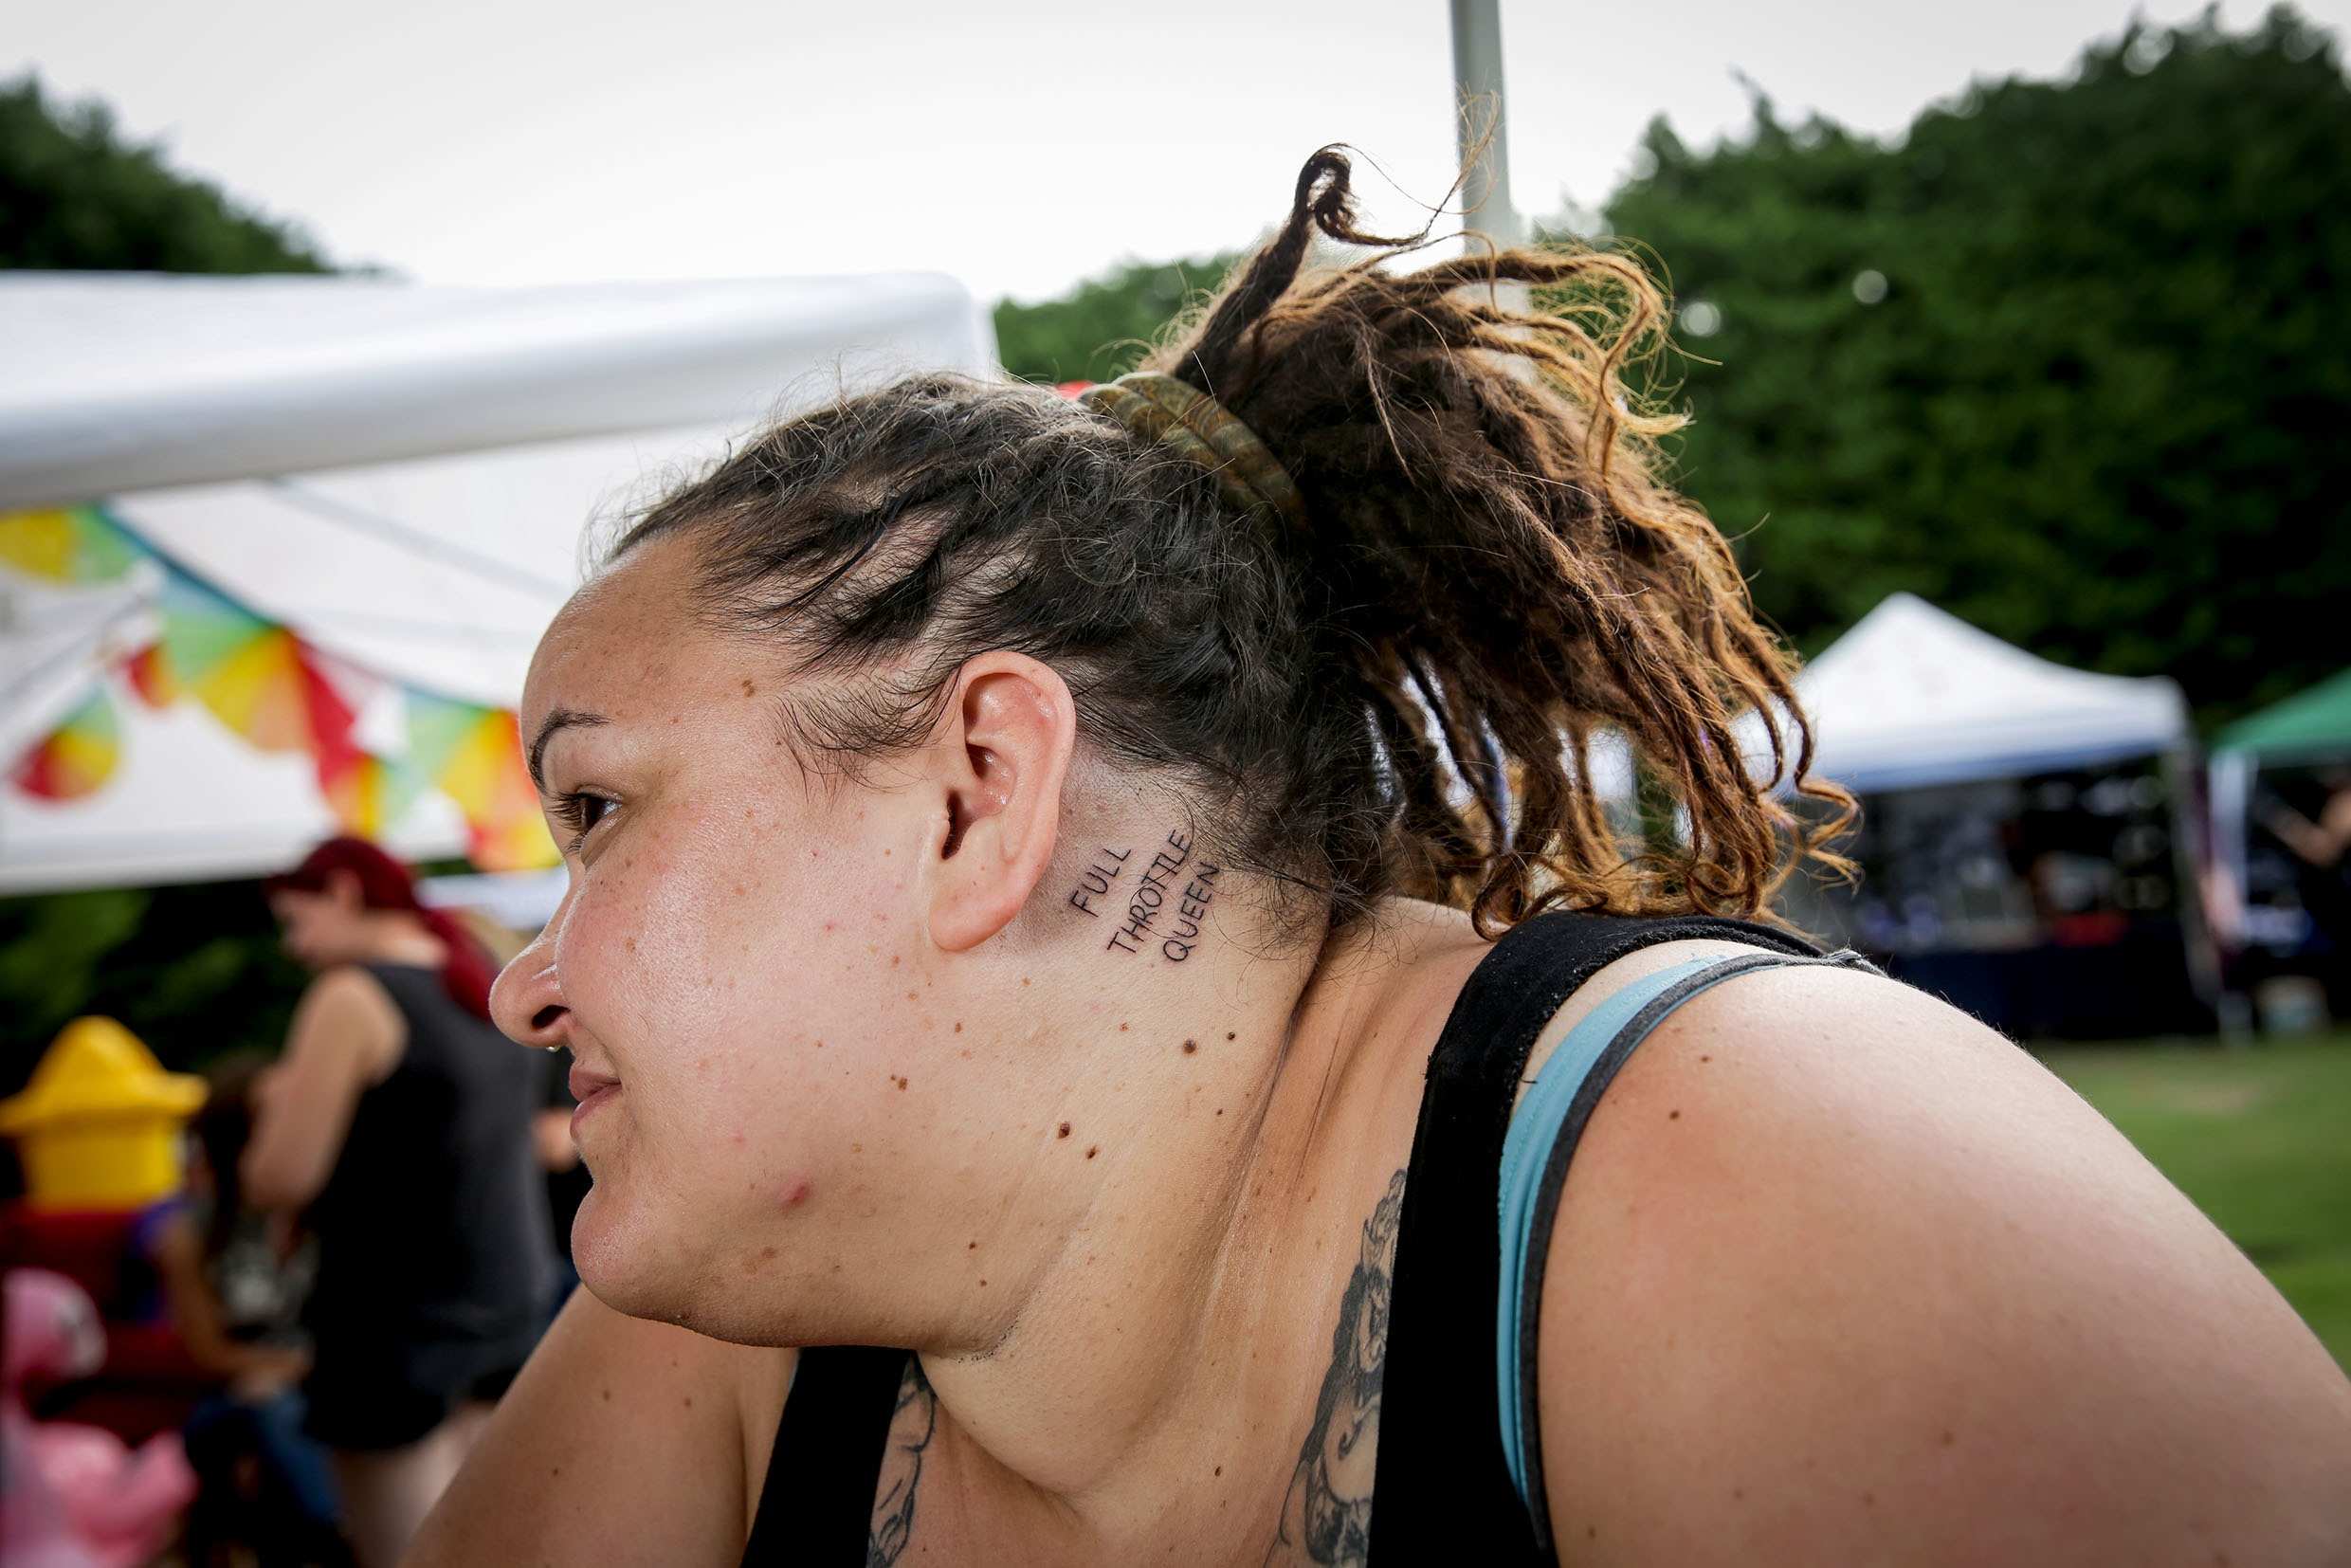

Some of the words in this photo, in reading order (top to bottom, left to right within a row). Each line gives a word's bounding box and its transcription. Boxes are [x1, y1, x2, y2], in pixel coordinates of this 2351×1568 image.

[1069, 848, 1132, 918] FULL
[1106, 829, 1191, 954] THROTTLE
[1162, 861, 1221, 962] QUEEN
